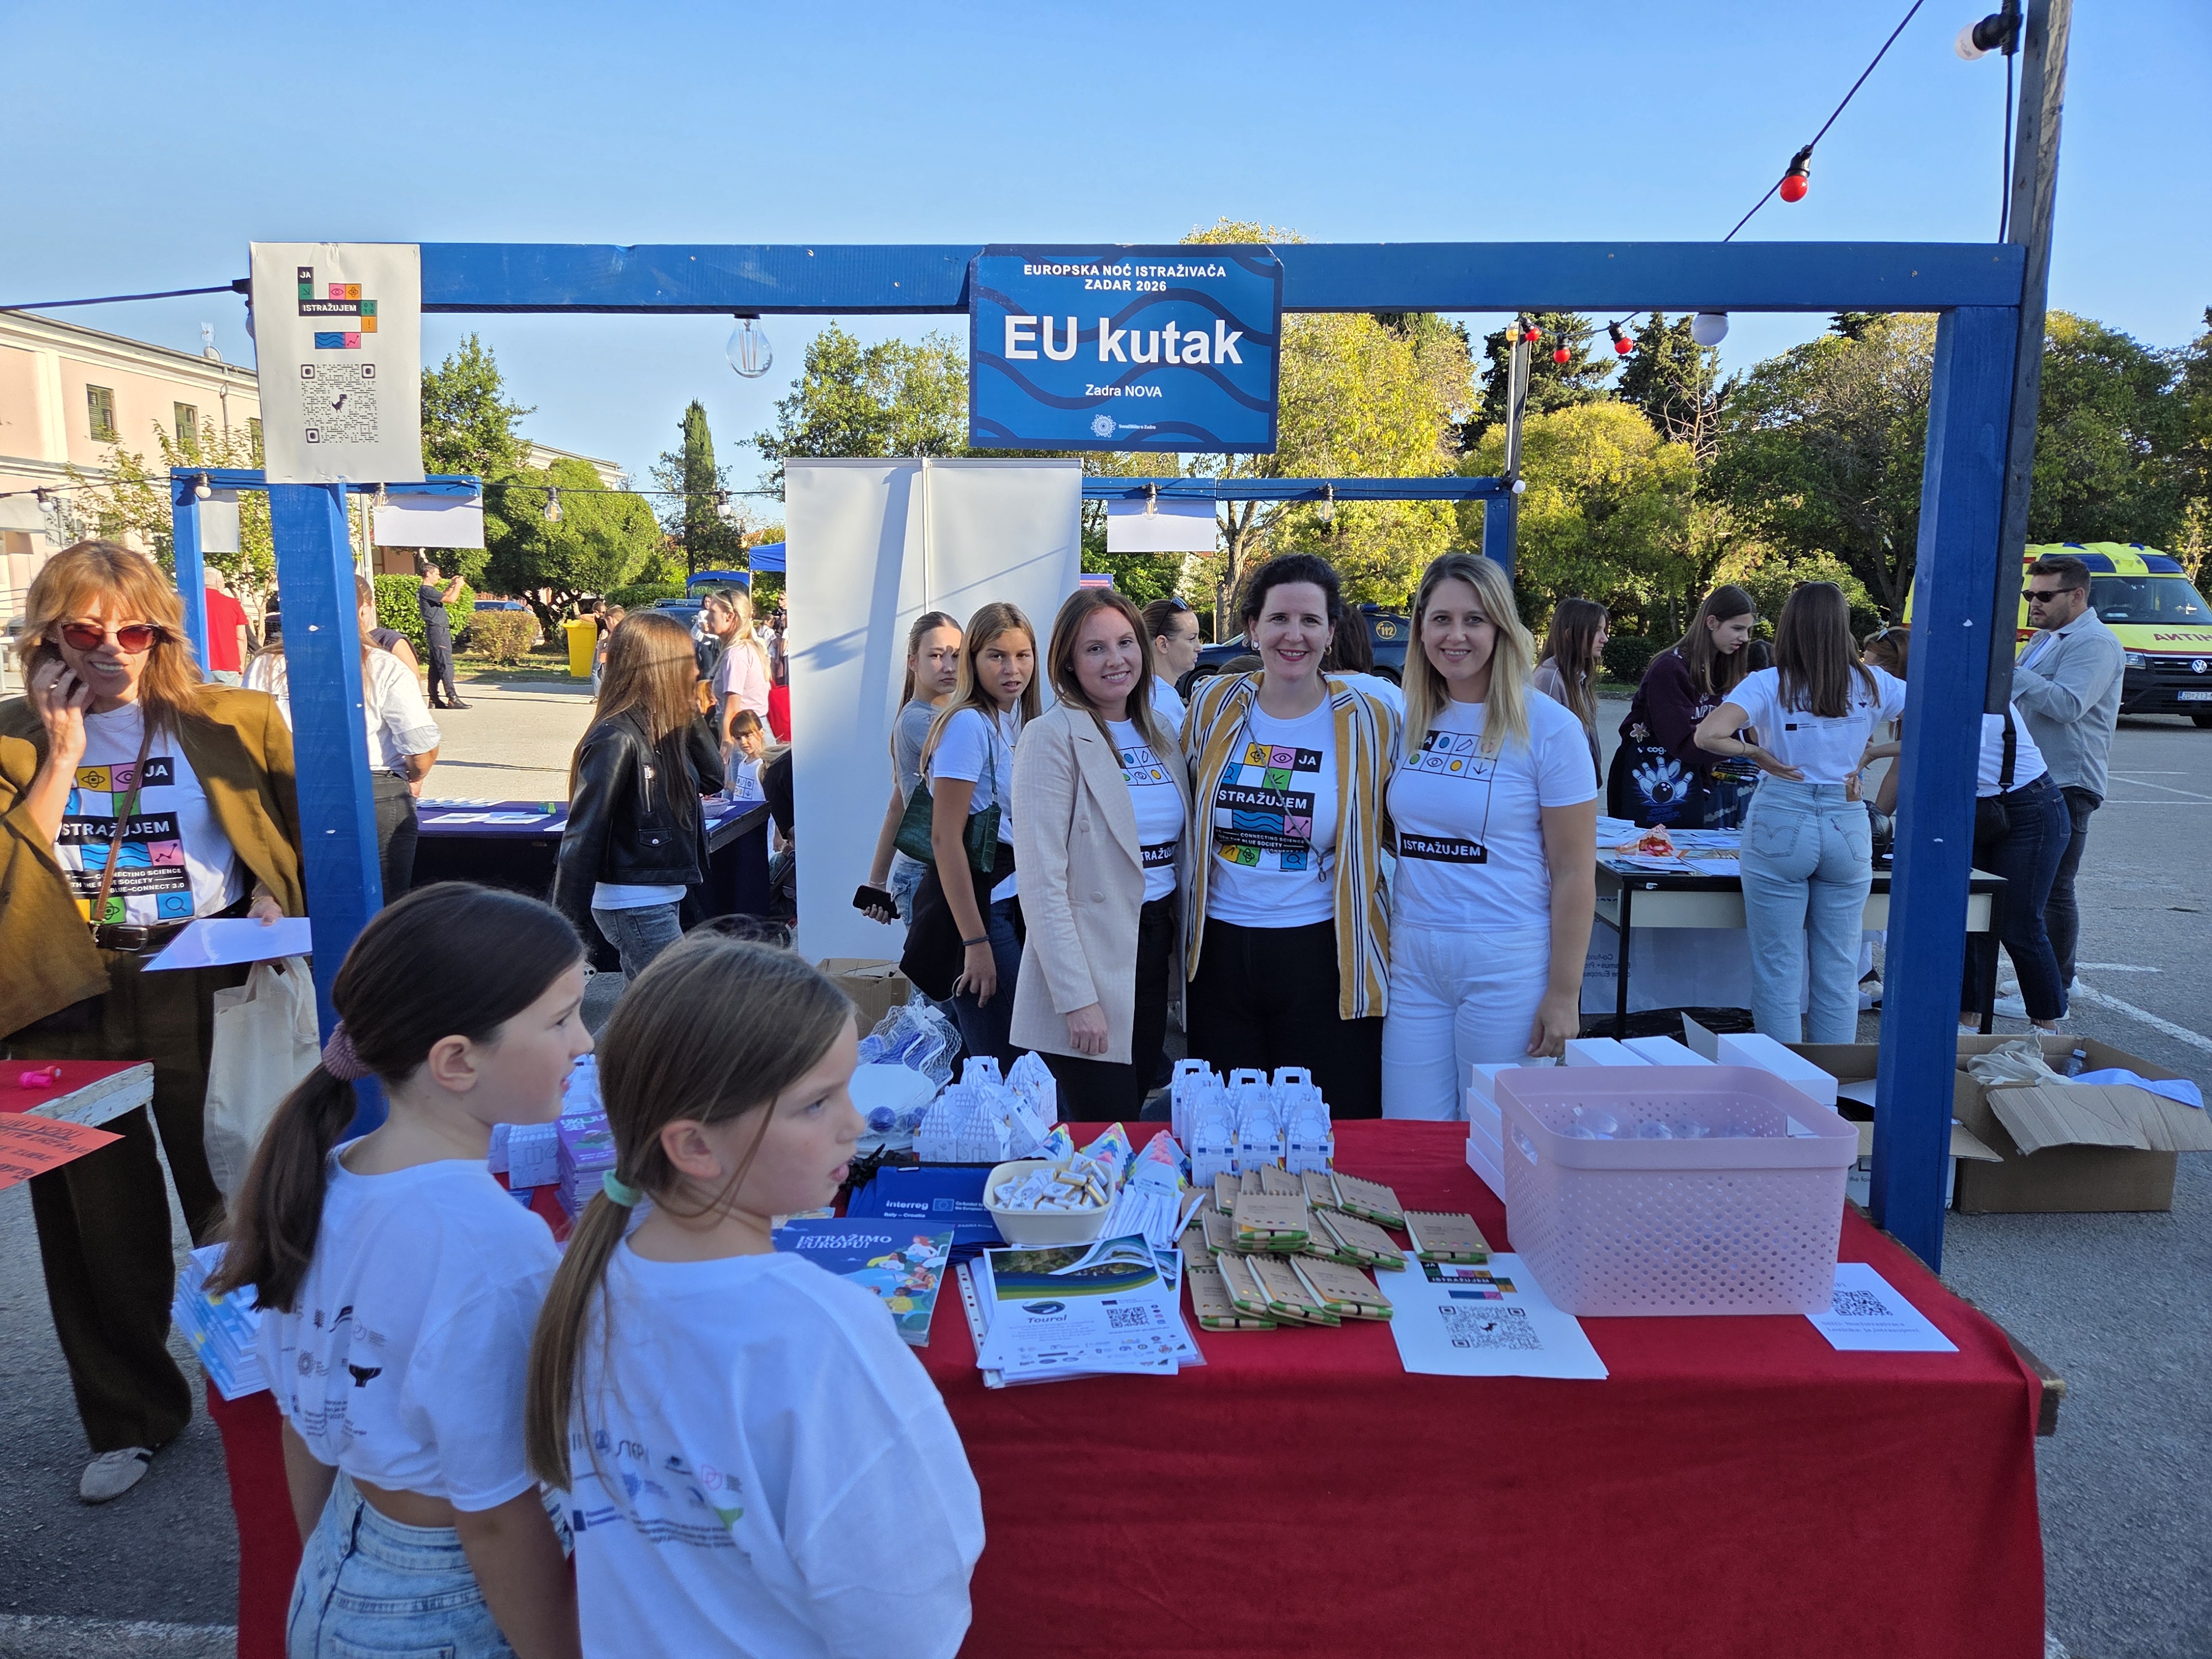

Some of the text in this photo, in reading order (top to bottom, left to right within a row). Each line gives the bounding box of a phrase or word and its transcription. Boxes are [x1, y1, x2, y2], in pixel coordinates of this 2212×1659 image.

[1024, 263, 1226, 277] EUROPSKA NOĆ ISTRAŽIVAČA
[1084, 279, 1167, 292] ZADAR 2026
[303, 304, 357, 312] ISTRAŽUJEM
[1005, 315, 1243, 364] EU kutak
[1085, 384, 1162, 398] Zadra NOVA
[1381, 627, 1394, 635] 112
[1298, 755, 1317, 765] JA
[145, 765, 168, 778] JA
[1218, 790, 1307, 809] STRAŽUJEM
[61, 821, 170, 837] STRAŽUJEM
[1240, 832, 1278, 841] CONNECTING
[1404, 839, 1481, 857] ISTRAŽUJEM
[886, 1200, 928, 1211] Interreg
[799, 1234, 892, 1243] ISTRAŽIMO
